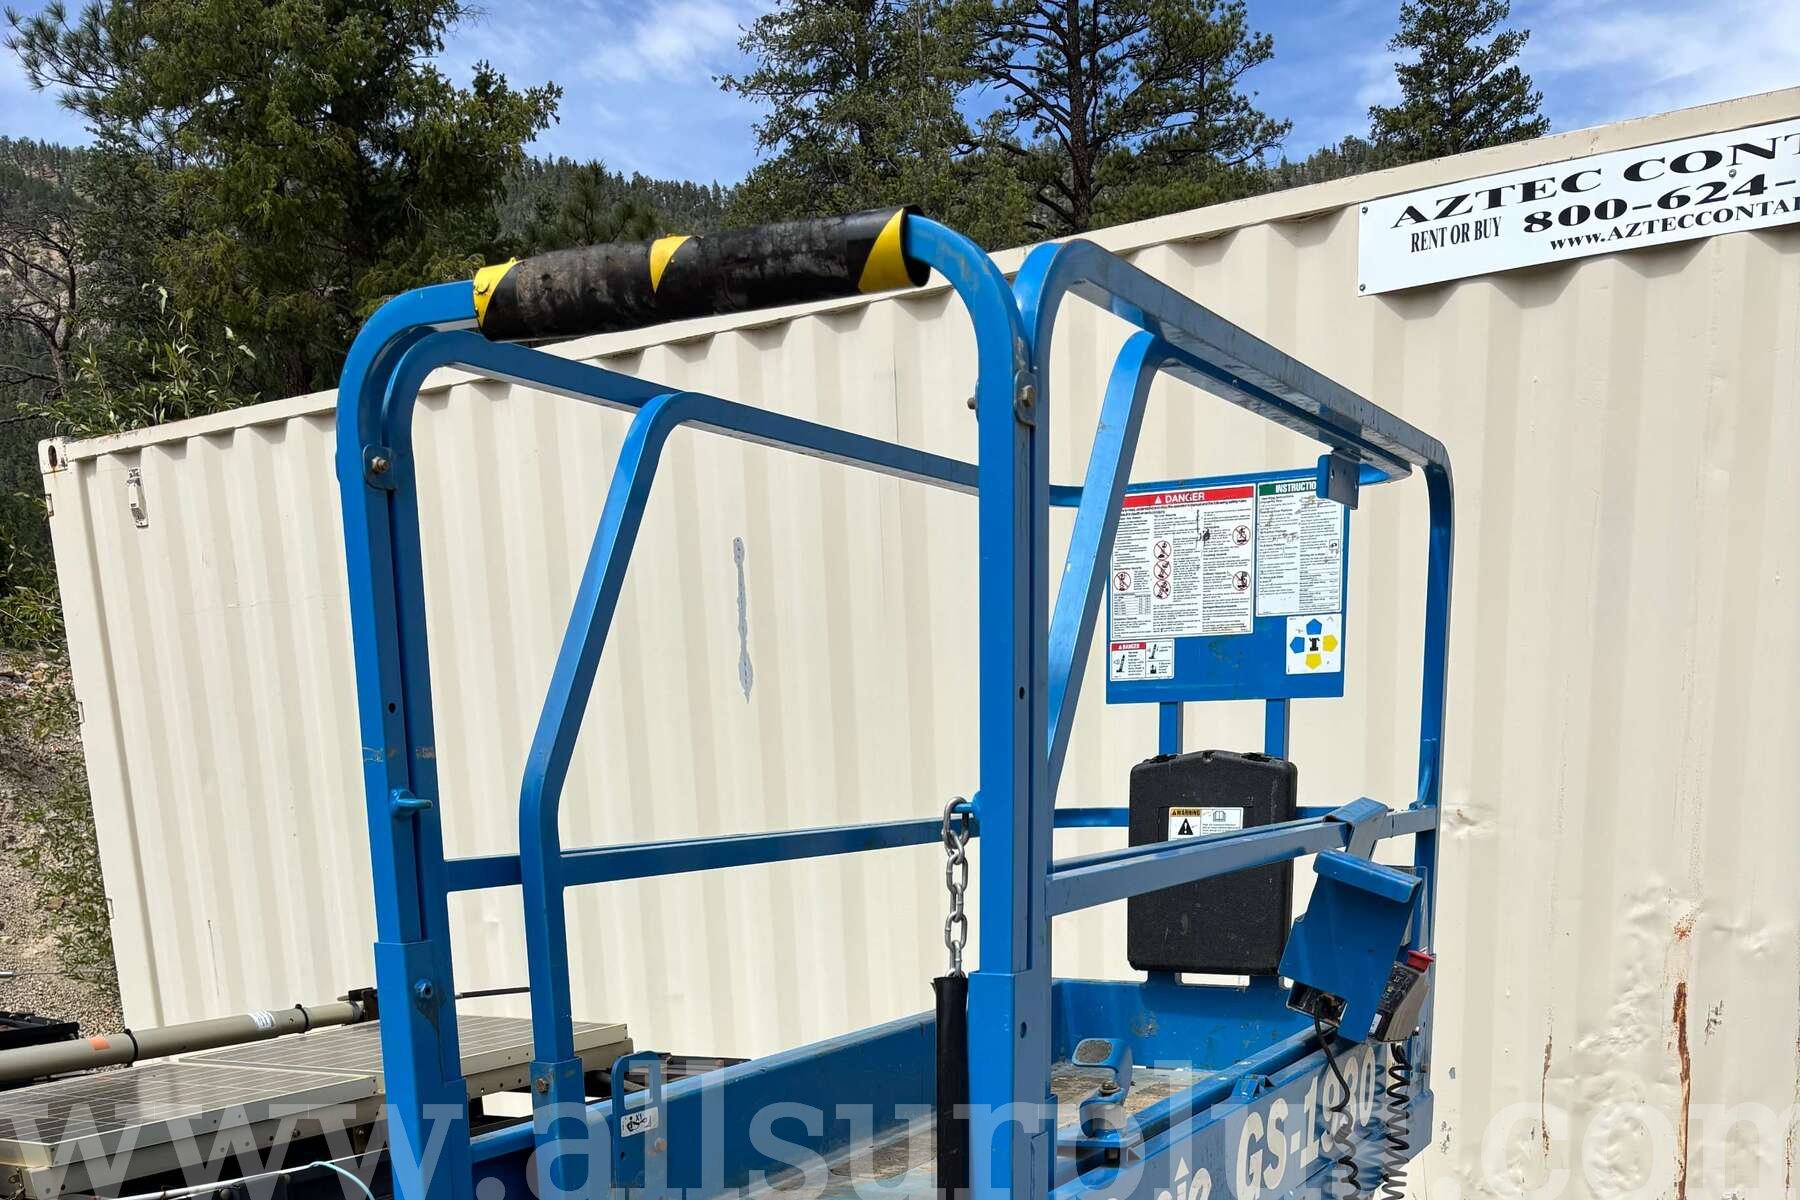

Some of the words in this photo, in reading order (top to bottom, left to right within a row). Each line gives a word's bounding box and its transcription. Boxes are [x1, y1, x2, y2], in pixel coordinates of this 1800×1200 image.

[1390, 168, 1602, 229] AZTEC
[1523, 173, 1796, 233] 800-624-
[1410, 227, 1448, 253] RENT
[1450, 222, 1470, 245] OR
[1474, 216, 1502, 241] BUY
[1164, 492, 1206, 504] DANGER
